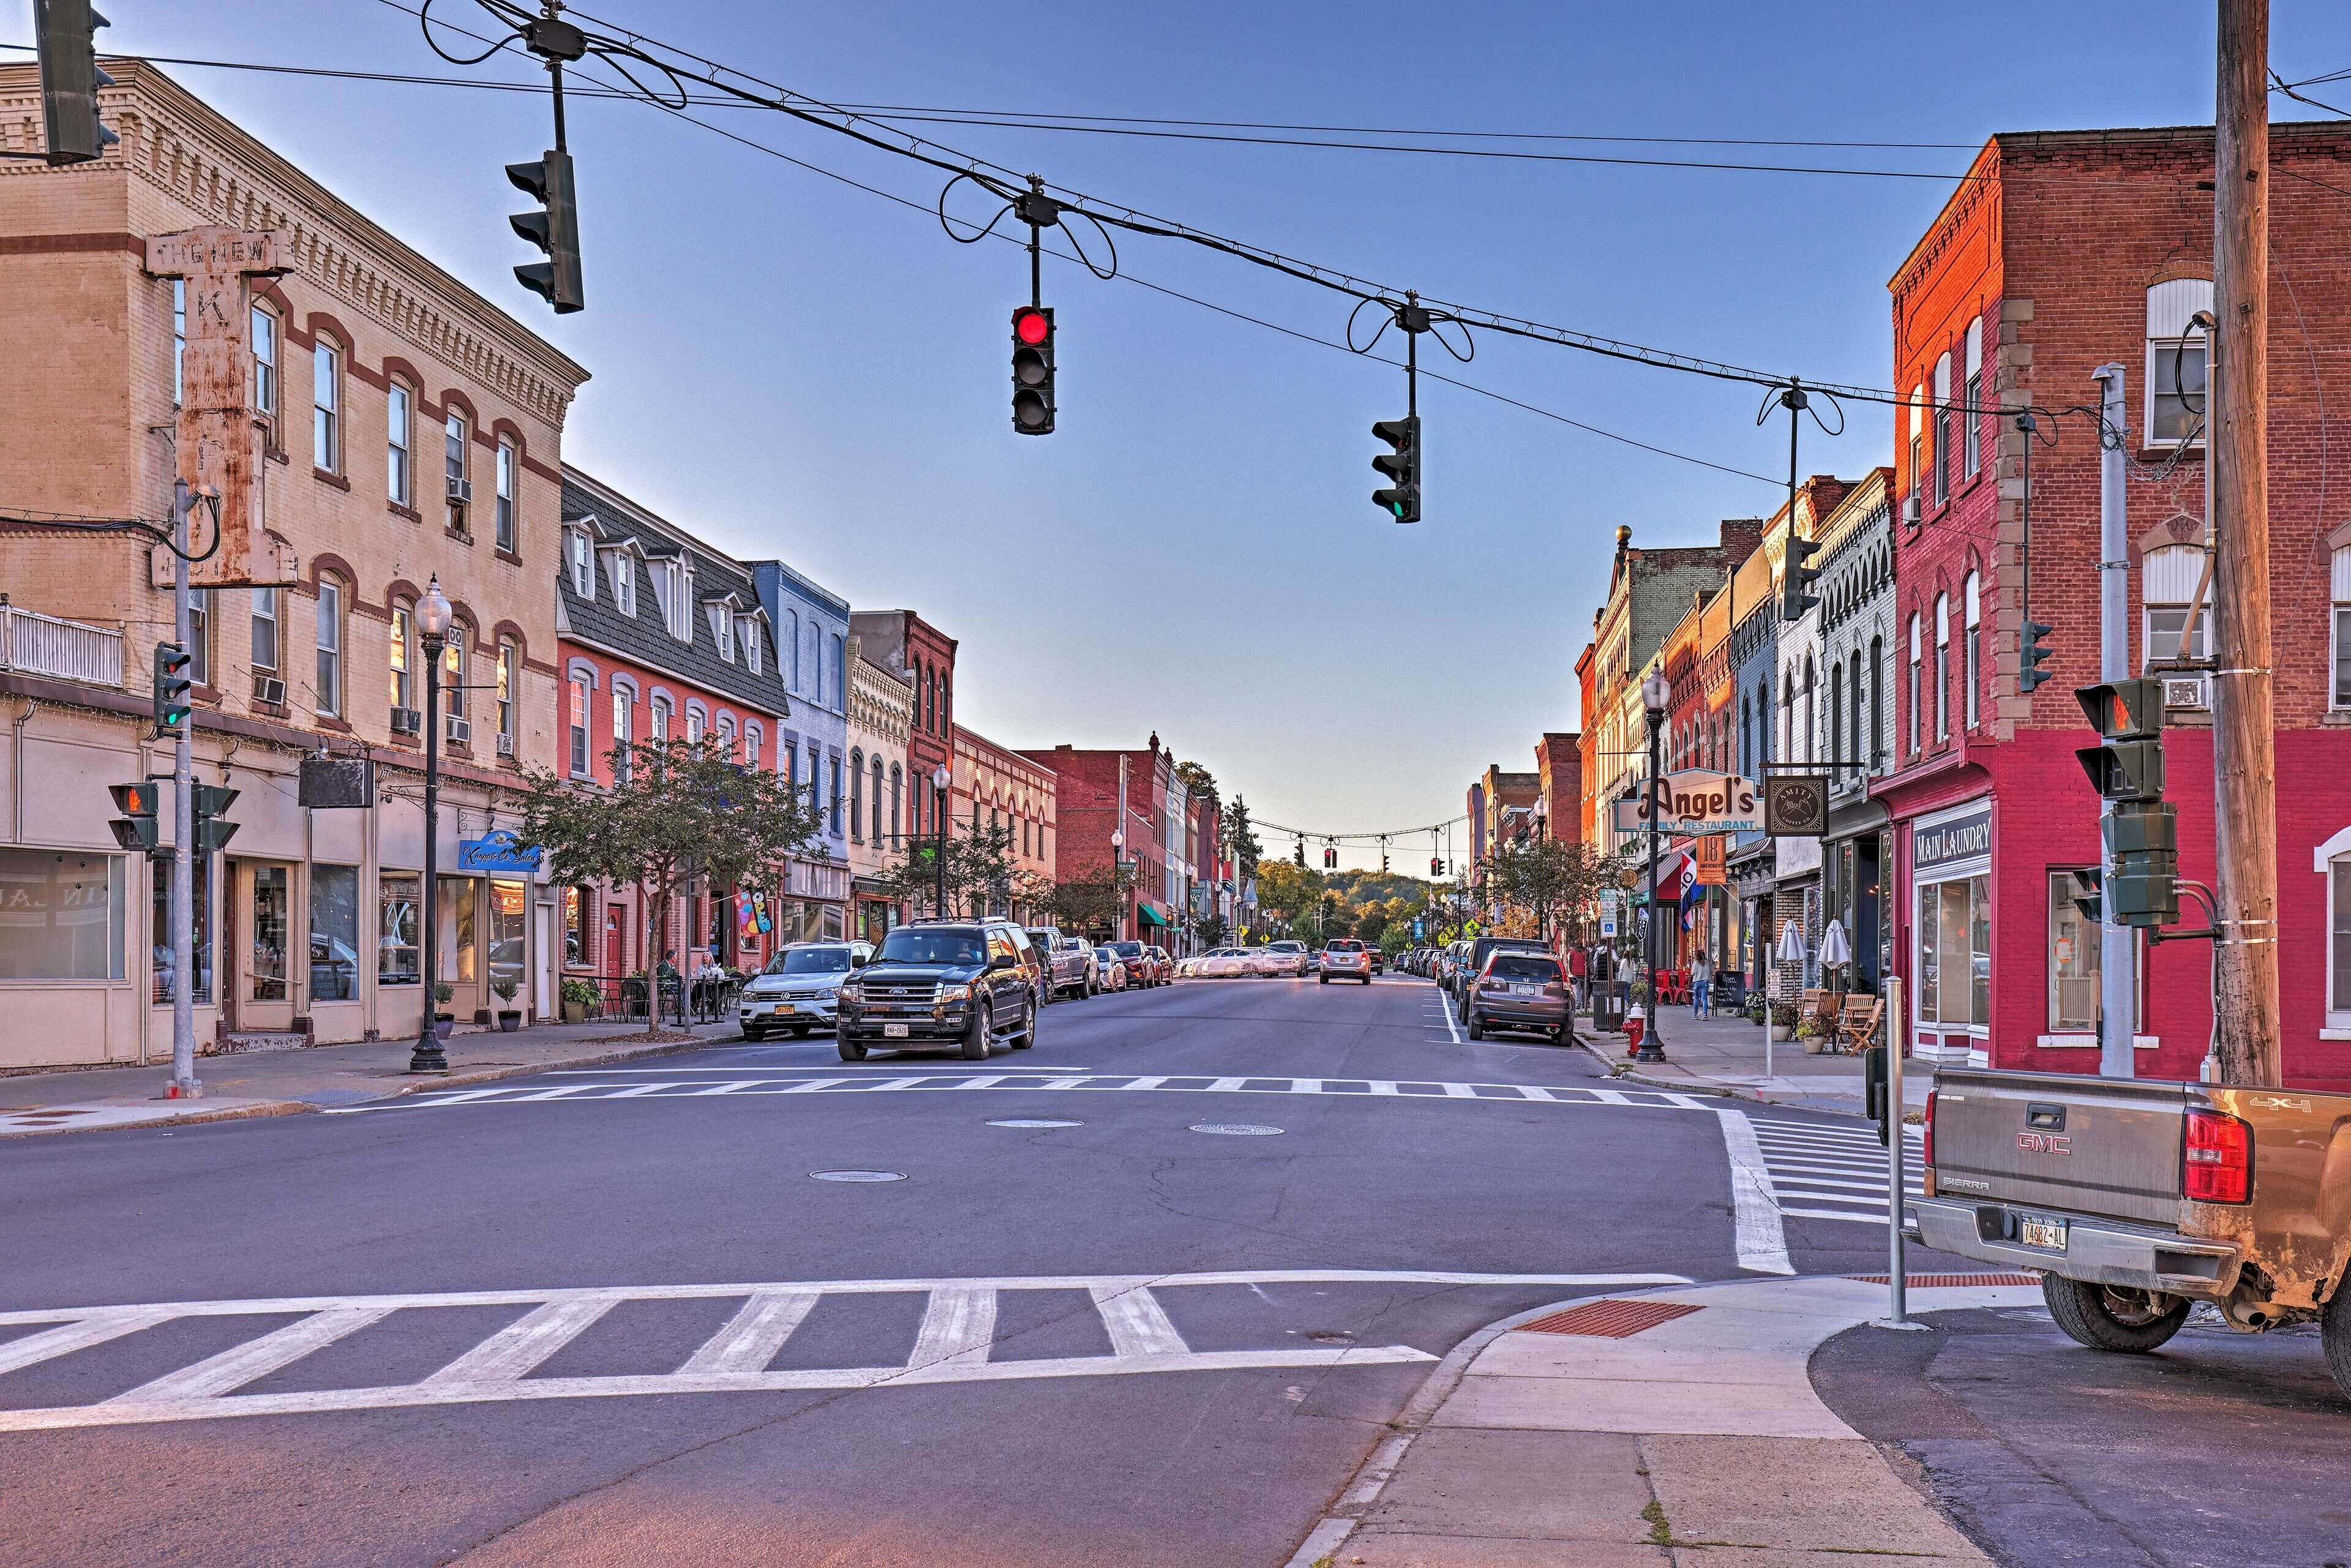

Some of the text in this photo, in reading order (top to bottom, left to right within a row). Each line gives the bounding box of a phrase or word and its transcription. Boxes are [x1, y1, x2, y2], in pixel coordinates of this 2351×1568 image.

[1637, 776, 1754, 824] Angel's
[1780, 788, 1813, 801] AMITY
[1684, 820, 1755, 830] RESTAURANT
[1782, 816, 1802, 825] COFFEE
[1917, 816, 1992, 863] MAIN LAUNDRY
[752, 891, 771, 933] OPEN
[2017, 1132, 2072, 1155] GMC
[1943, 1177, 1990, 1191] SIERRA
